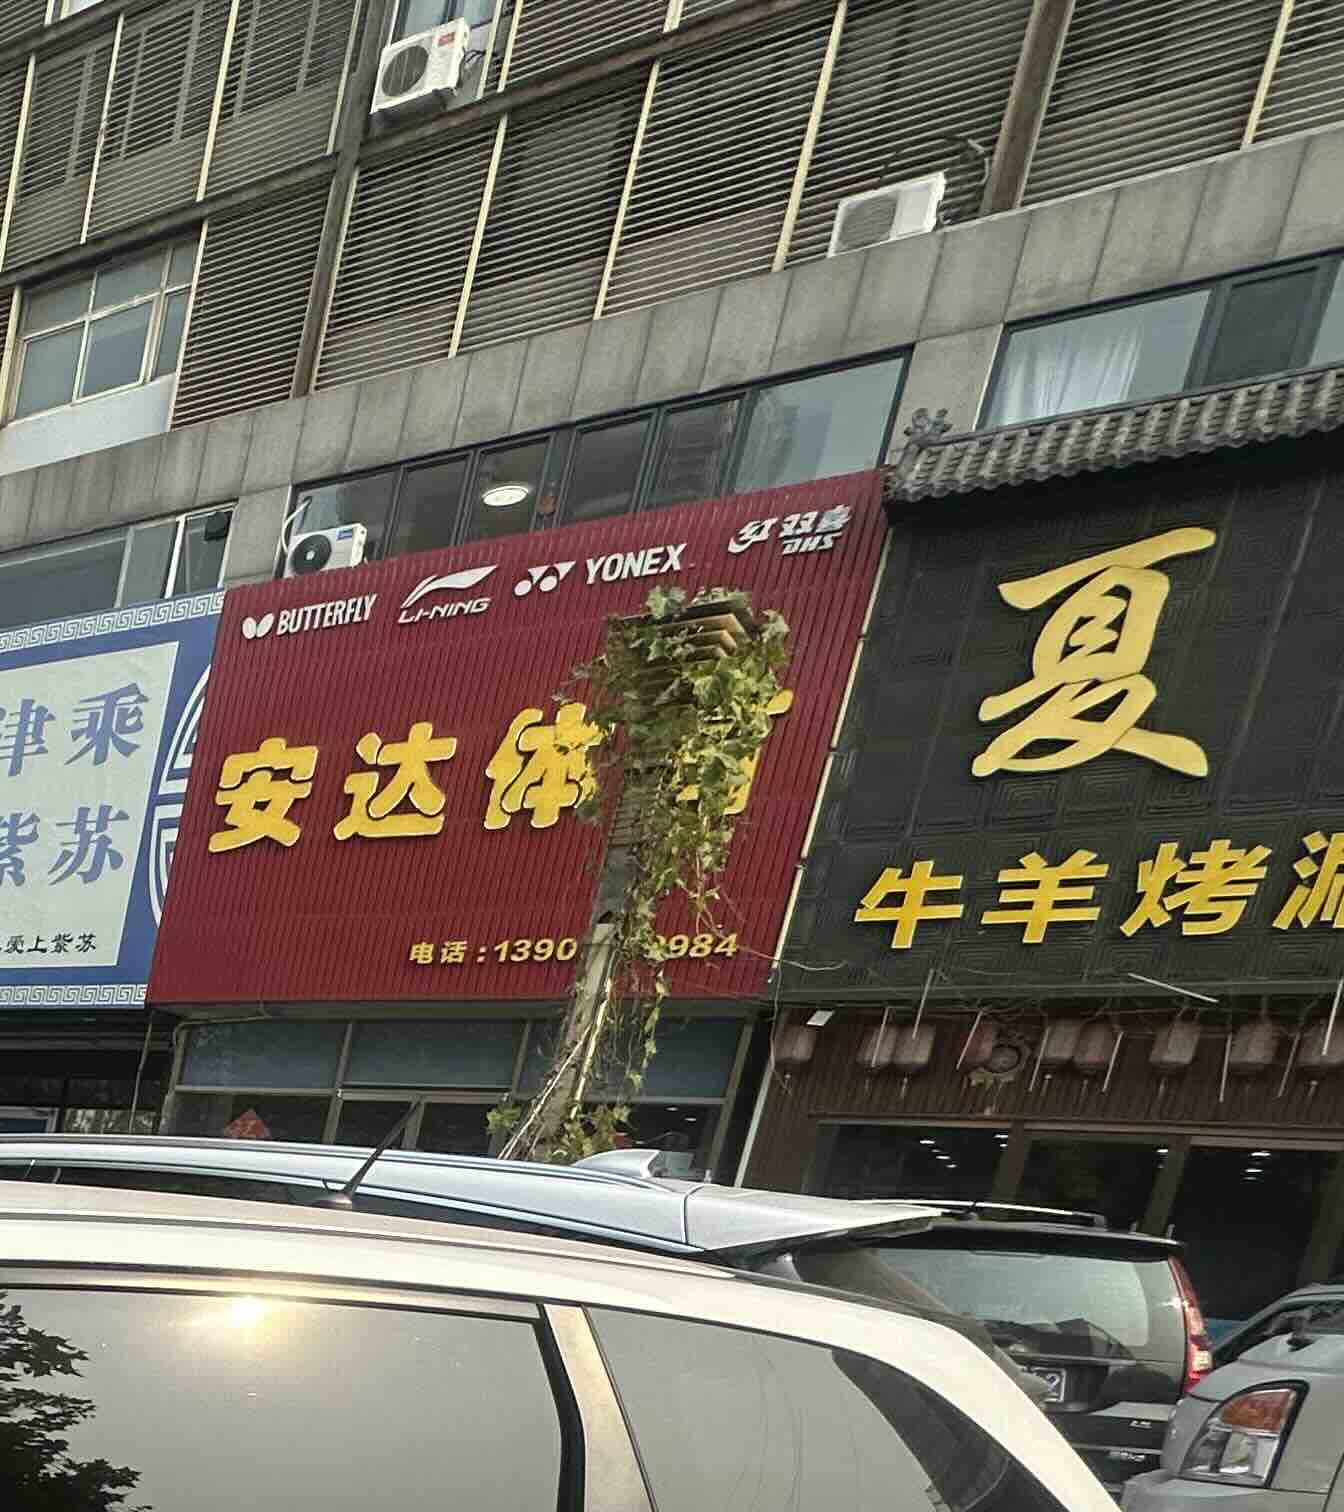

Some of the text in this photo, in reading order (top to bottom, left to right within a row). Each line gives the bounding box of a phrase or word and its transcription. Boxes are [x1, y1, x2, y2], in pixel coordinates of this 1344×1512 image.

[585, 543, 688, 585] YONEX
[276, 593, 378, 636] BUTTERFLY
[397, 597, 492, 624] LI-NING
[972, 527, 1216, 777] 夏
